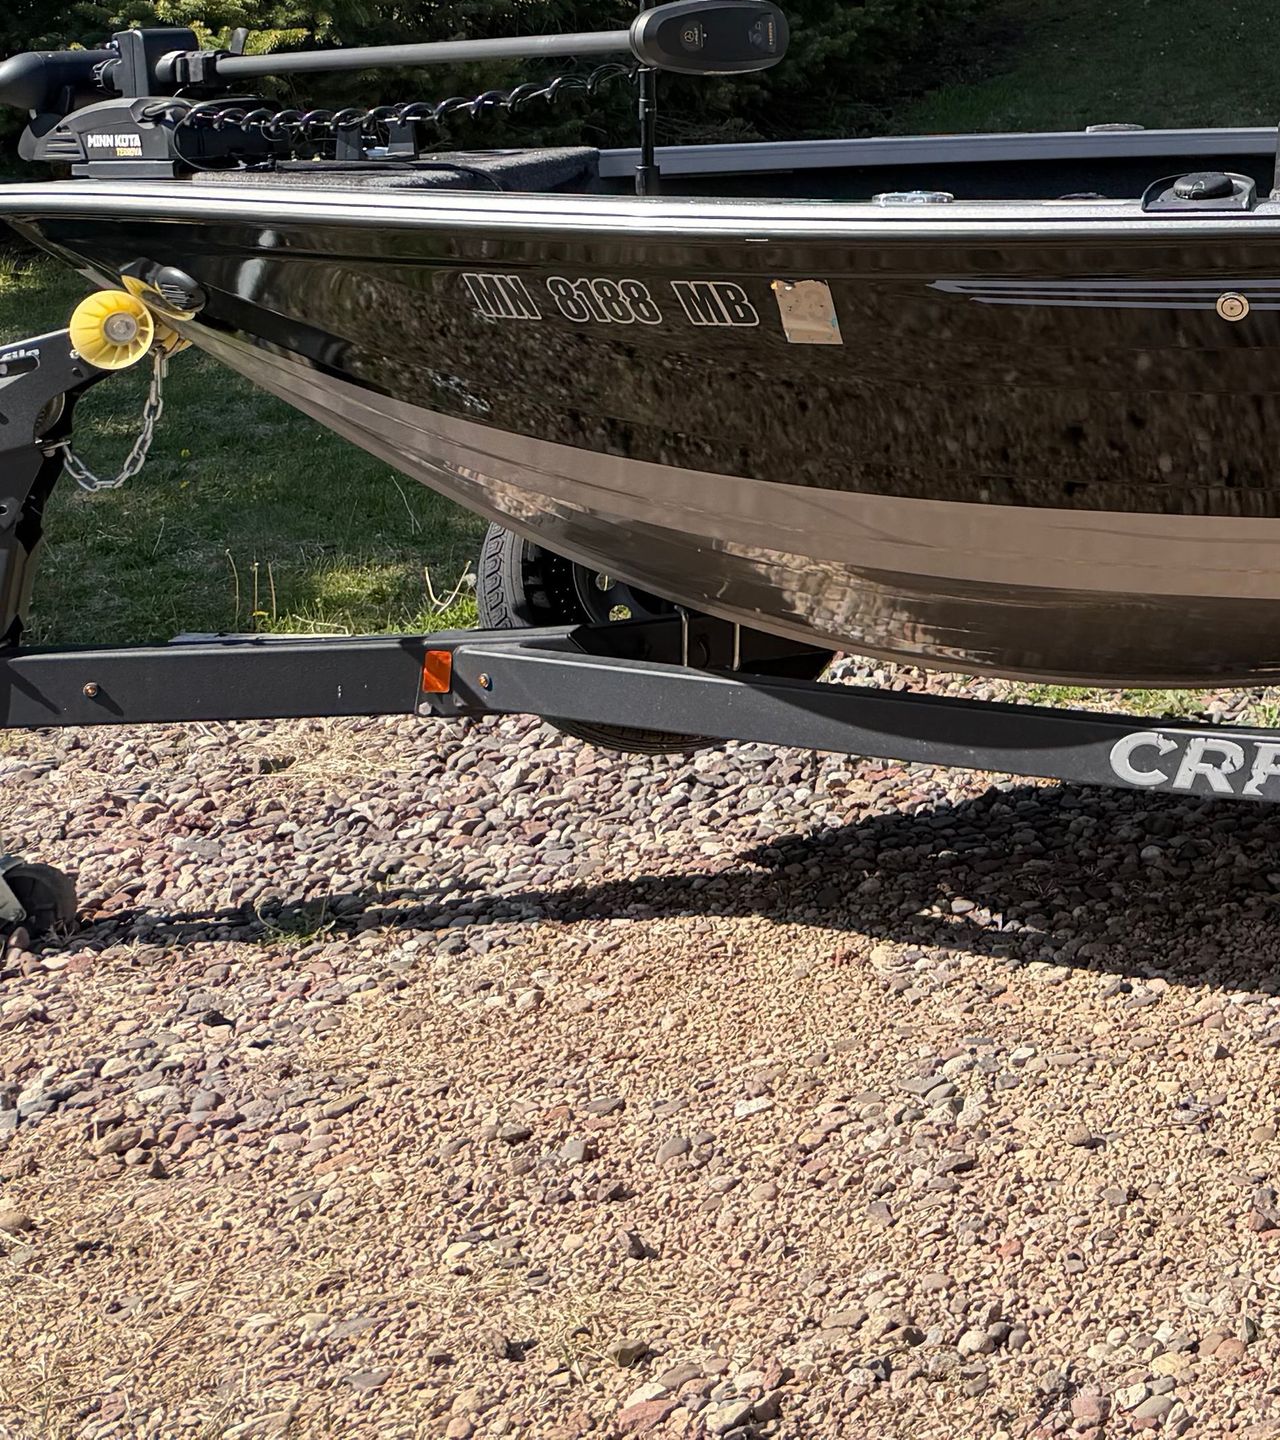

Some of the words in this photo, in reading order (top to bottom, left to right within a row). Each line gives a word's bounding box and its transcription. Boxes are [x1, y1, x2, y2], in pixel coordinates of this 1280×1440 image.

[87, 134, 113, 148] MINN
[114, 133, 142, 147] KOTA
[462, 273, 542, 320] MN
[546, 276, 663, 324] 8188
[670, 281, 760, 326] MB
